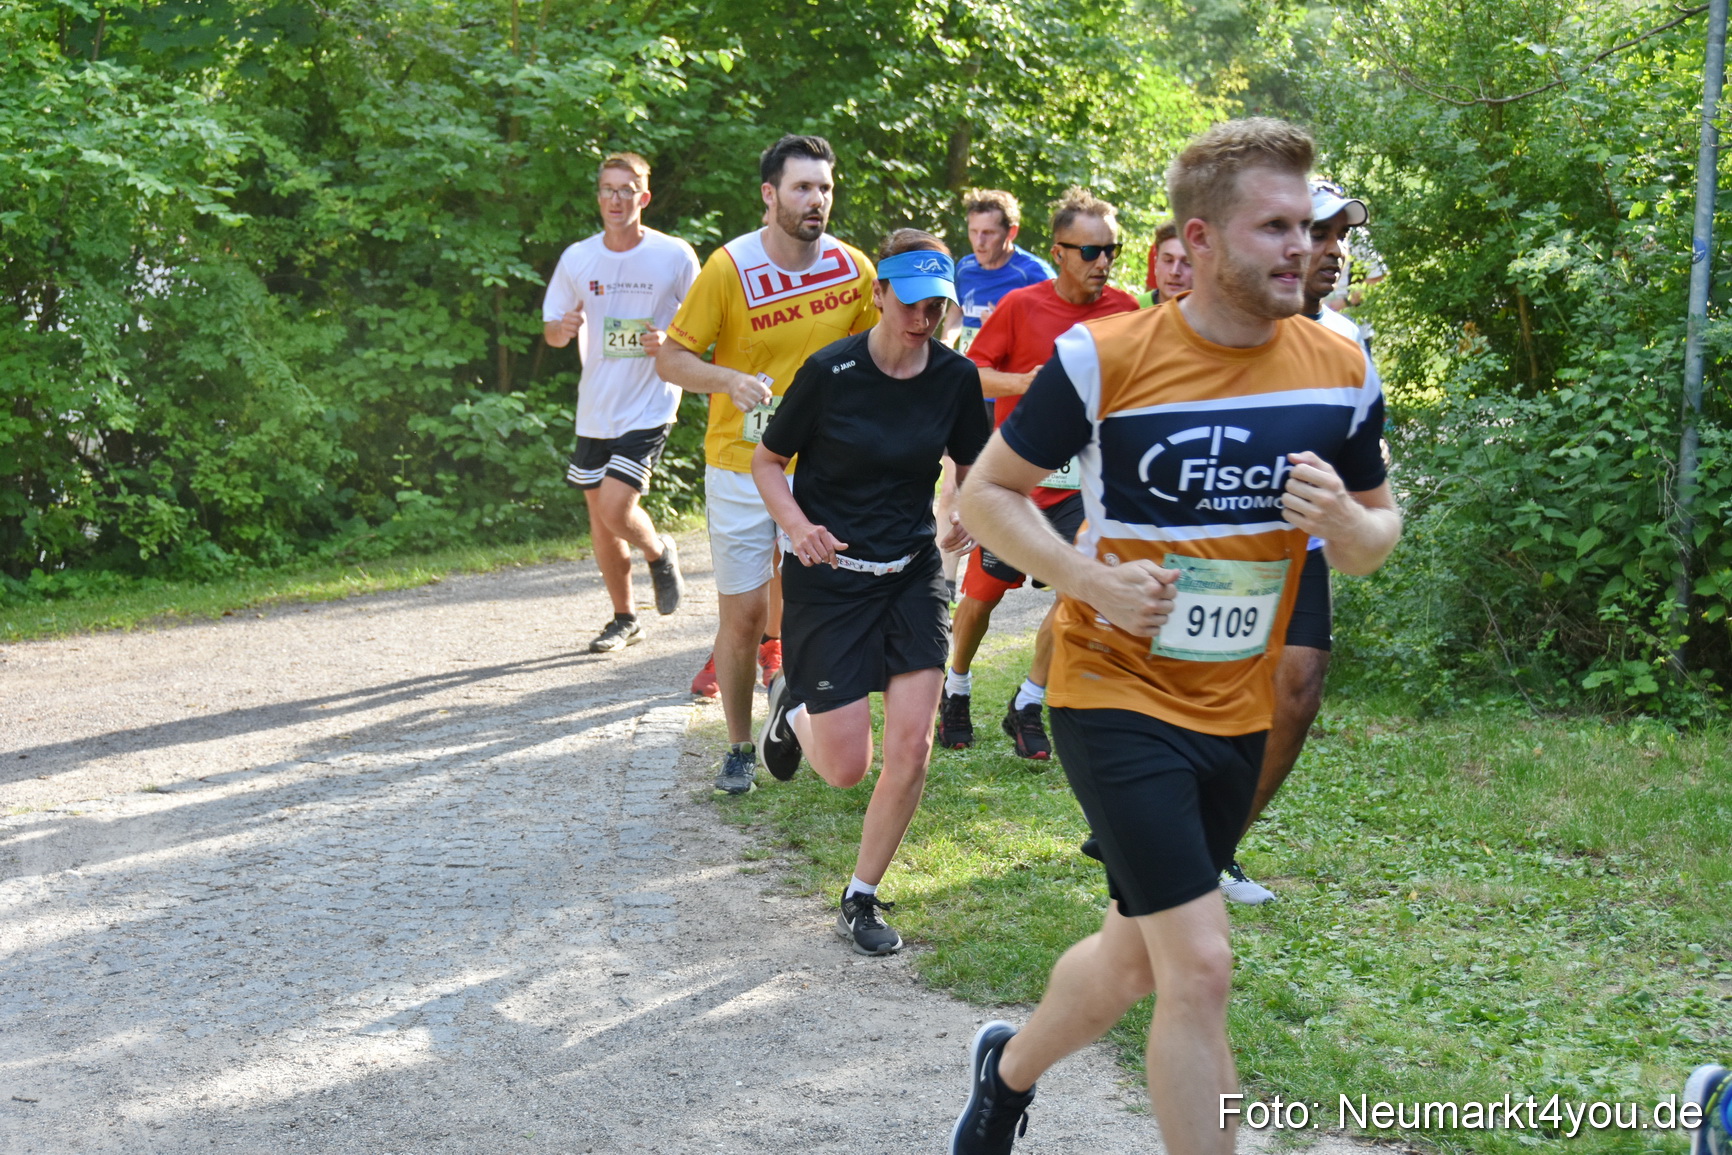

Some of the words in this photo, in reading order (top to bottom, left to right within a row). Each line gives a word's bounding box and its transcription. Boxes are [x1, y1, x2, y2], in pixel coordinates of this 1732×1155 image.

[606, 282, 654, 291] SCHWARZ
[750, 305, 804, 332] MAX
[809, 287, 862, 316] BÖGL
[840, 360, 856, 371] JAKO
[1178, 456, 1294, 492] Fisch
[1186, 605, 1258, 638] 9109
